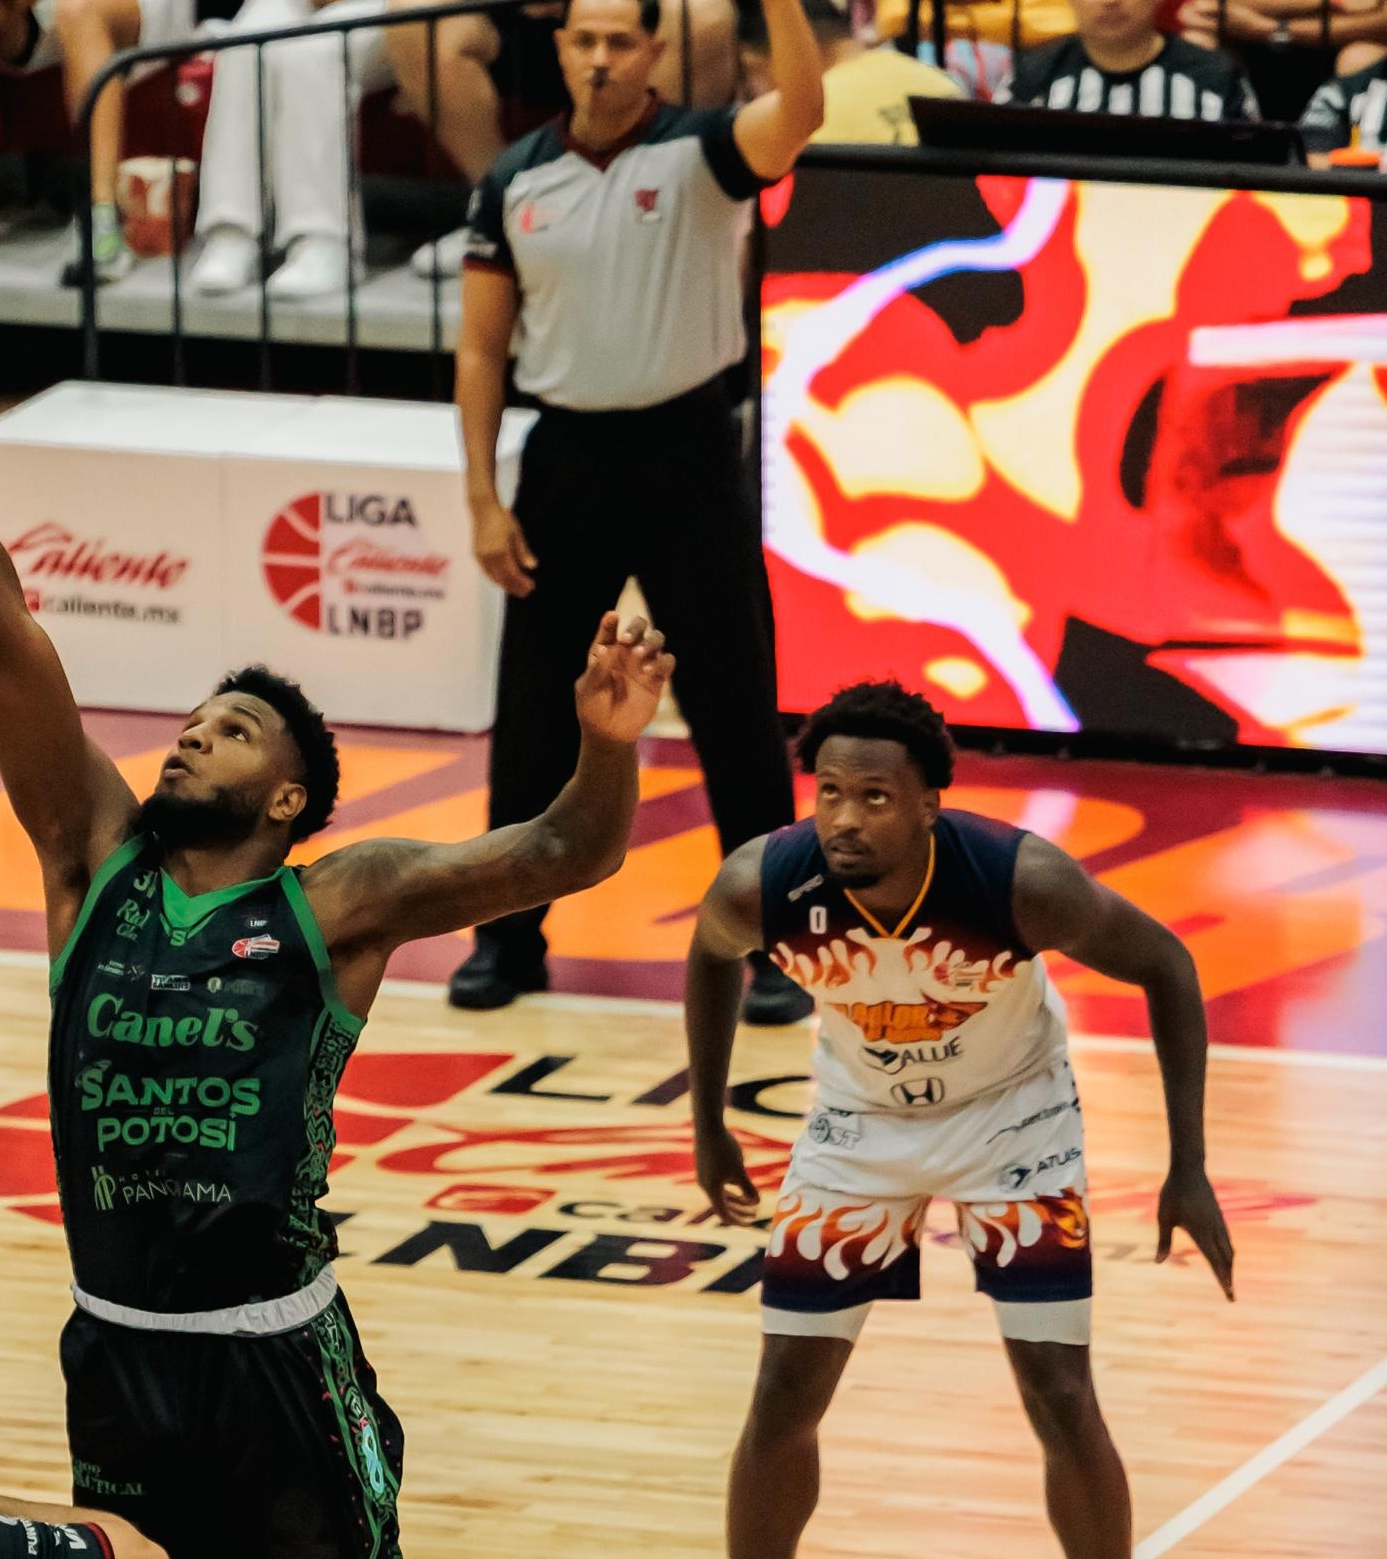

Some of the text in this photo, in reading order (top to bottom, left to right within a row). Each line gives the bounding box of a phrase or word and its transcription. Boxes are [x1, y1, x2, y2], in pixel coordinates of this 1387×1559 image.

[325, 493, 419, 527] LIGA
[7, 522, 190, 590] Caliente
[327, 604, 425, 642] LNBP
[809, 905, 827, 934] 0
[87, 992, 258, 1052] Canel's
[81, 1070, 262, 1116] SANTOS
[329, 1212, 764, 1294] NB
